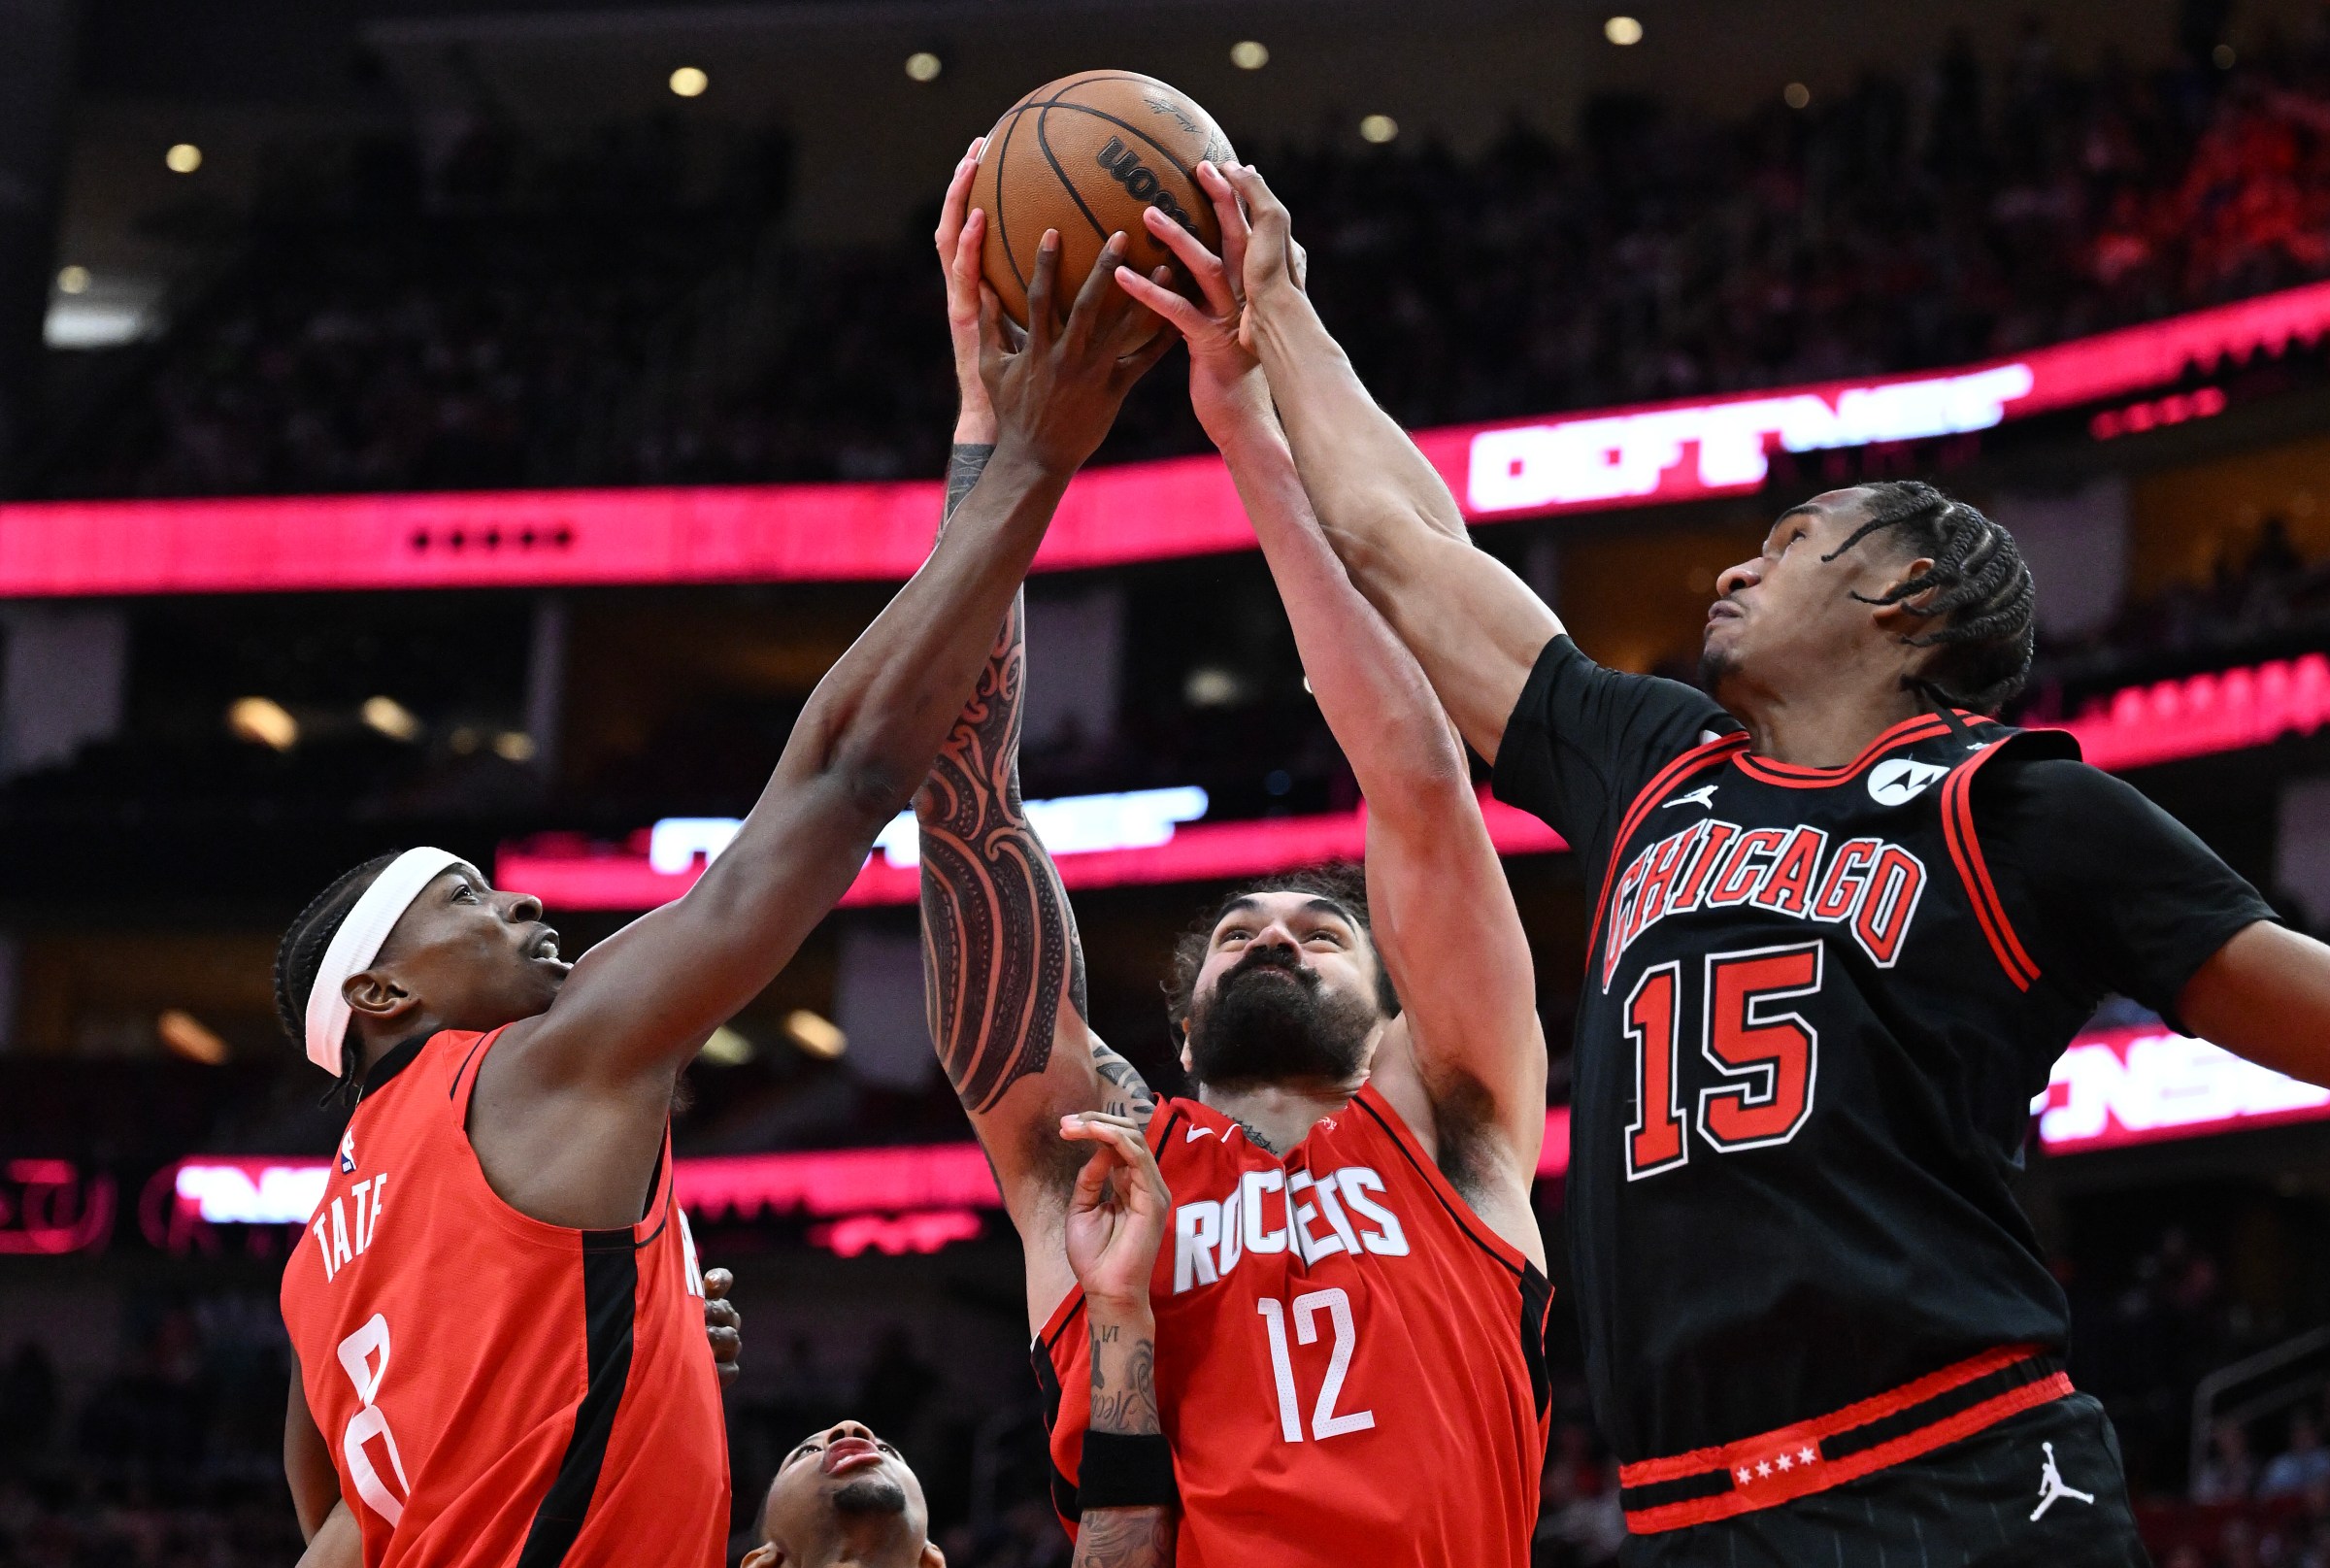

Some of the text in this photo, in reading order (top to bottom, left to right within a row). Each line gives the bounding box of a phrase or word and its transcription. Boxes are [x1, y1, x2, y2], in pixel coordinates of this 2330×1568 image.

[1602, 817, 1927, 994] CHICAGO
[1624, 939, 1823, 1182] 15
[337, 1313, 411, 1529] 8
[1257, 1287, 1376, 1443] 12
